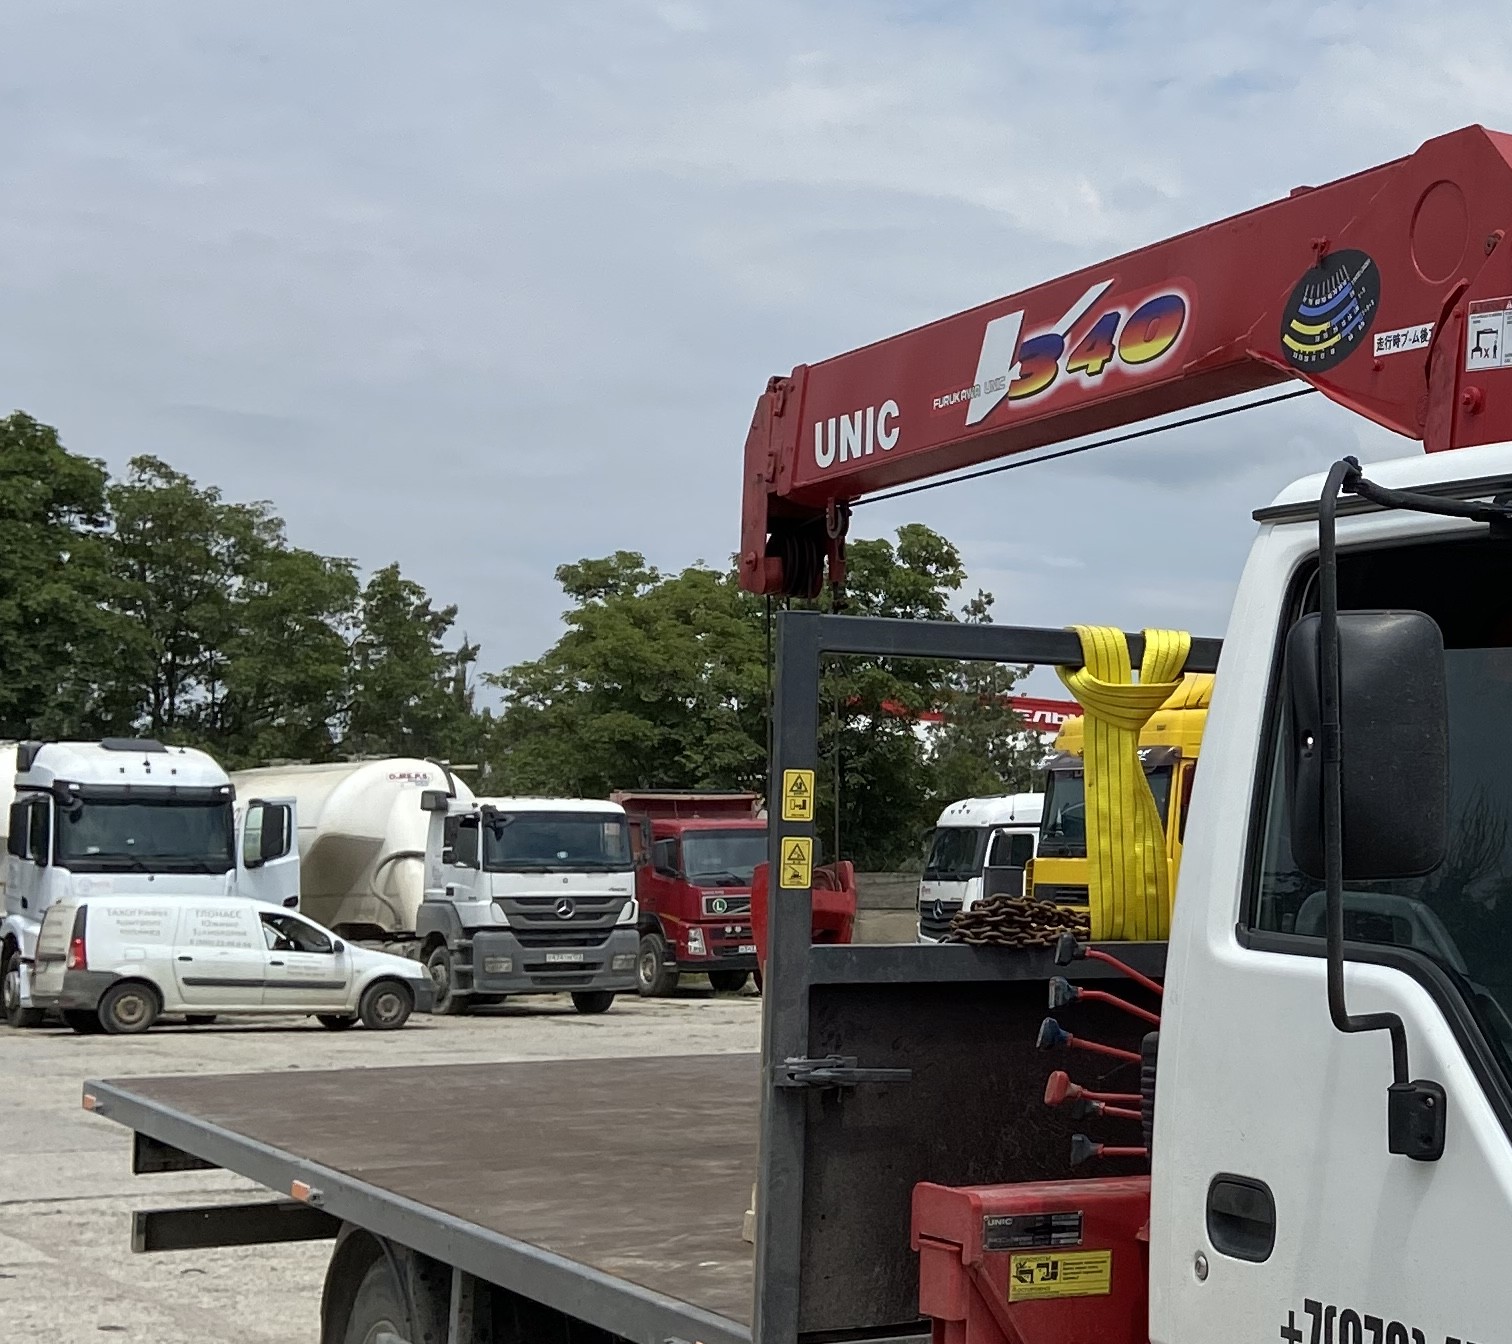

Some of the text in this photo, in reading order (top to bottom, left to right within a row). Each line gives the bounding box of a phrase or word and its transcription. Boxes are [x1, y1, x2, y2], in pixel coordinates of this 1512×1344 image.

[932, 375, 1007, 411] FURUKAWA UNIC
[814, 399, 900, 468] UNIC
